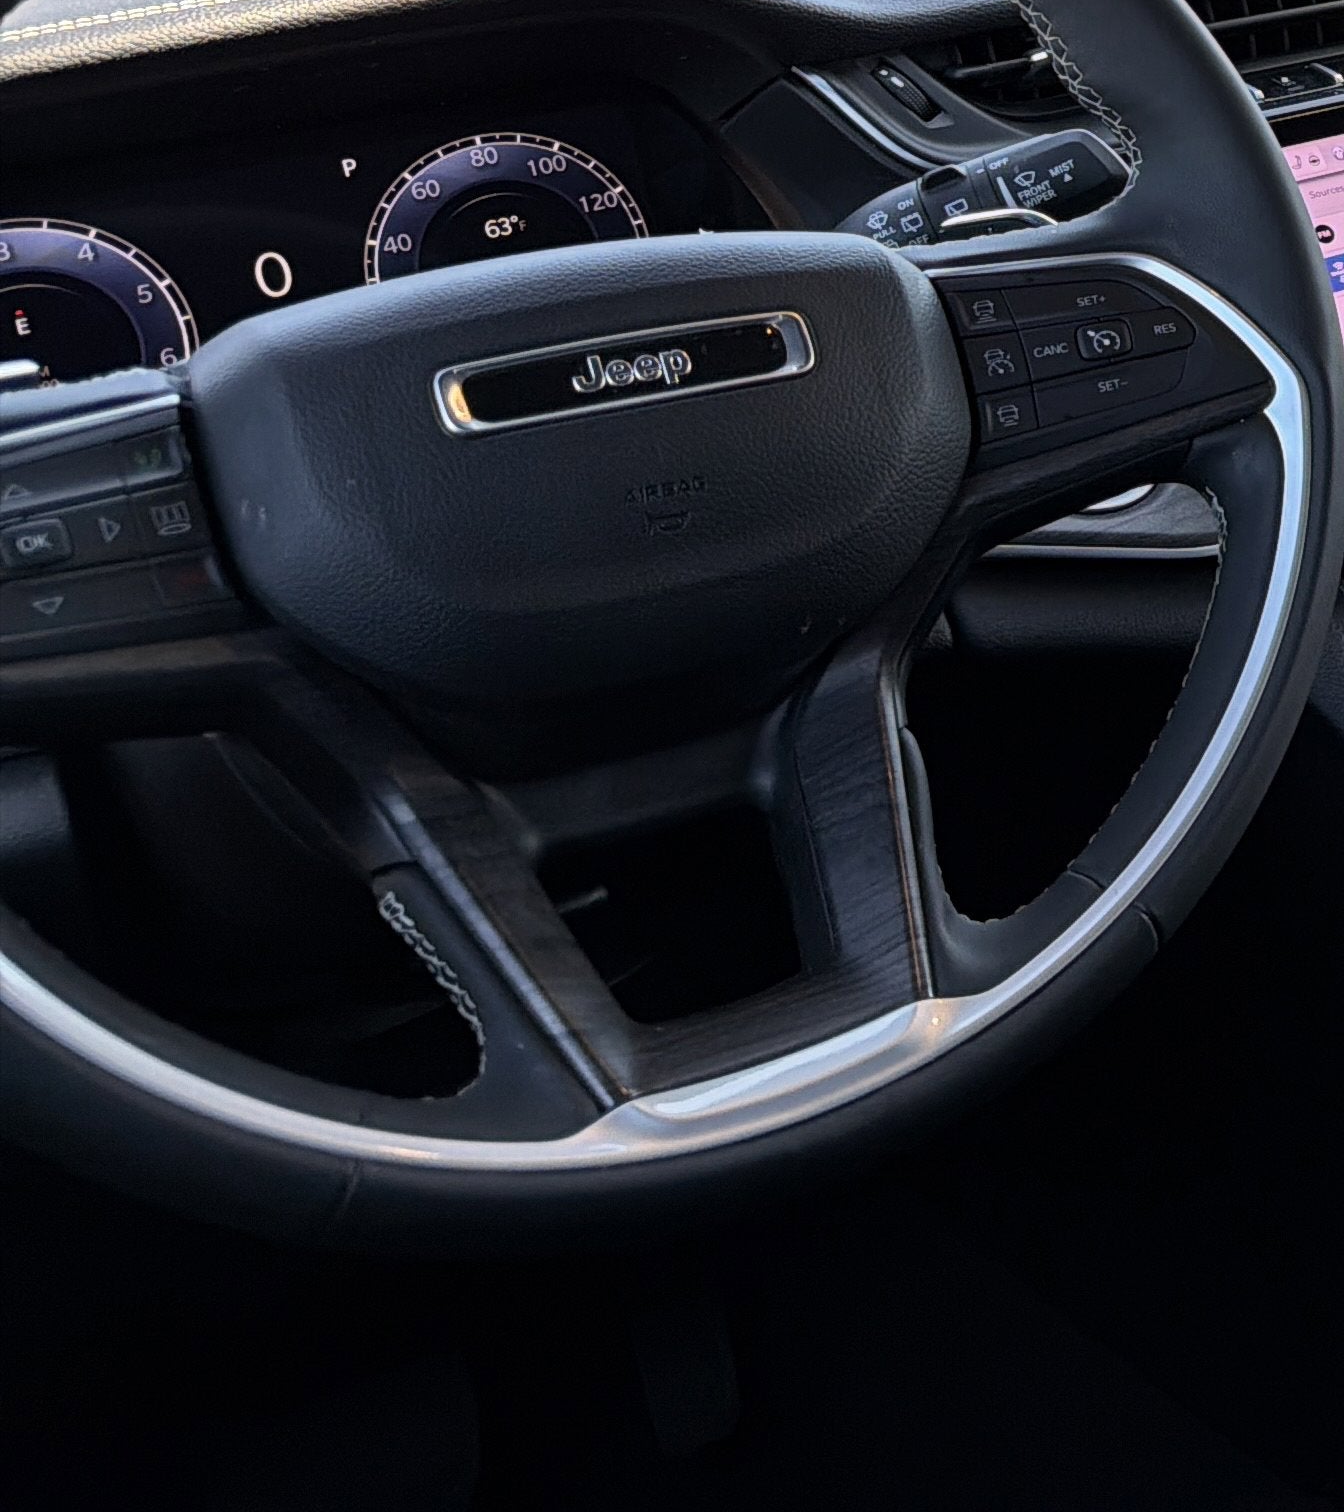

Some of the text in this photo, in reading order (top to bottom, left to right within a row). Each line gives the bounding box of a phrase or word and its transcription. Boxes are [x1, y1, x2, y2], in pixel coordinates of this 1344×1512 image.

[341, 158, 358, 178] P
[469, 146, 568, 178] 80 100
[988, 157, 1010, 171] OFF
[1048, 159, 1076, 179] MIST
[411, 178, 441, 201] 60
[1017, 180, 1052, 201] FRONT
[1022, 188, 1058, 210] WIPER
[578, 190, 619, 215] 120
[897, 198, 915, 212] ON
[383, 233, 413, 254] 40
[872, 226, 898, 241] PULL
[77, 242, 97, 262] 4
[254, 251, 294, 299] 0
[136, 283, 154, 304] 5
[1076, 293, 1107, 308] SET+
[15, 317, 33, 336] E
[1153, 322, 1178, 337] RES
[160, 347, 178, 367] 6
[1033, 342, 1070, 359] CANC
[572, 349, 693, 393] Jeep
